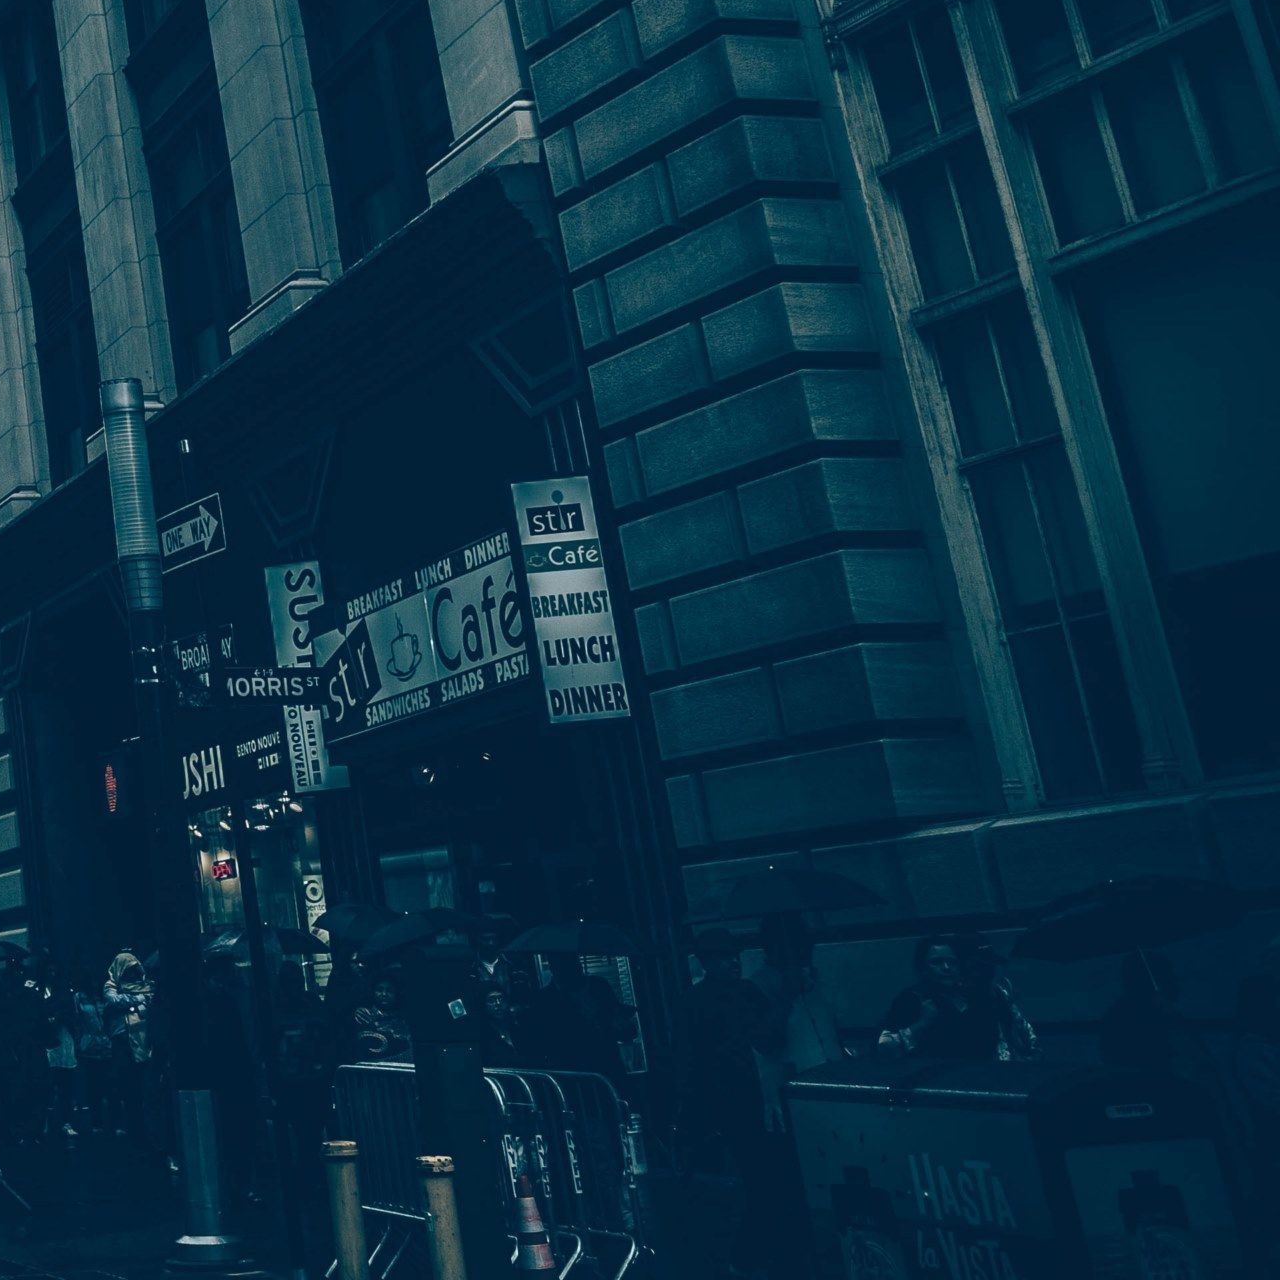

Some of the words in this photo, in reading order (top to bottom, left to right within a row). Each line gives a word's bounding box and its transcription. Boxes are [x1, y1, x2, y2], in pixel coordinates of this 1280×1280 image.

[165, 528, 185, 553] ONE
[190, 516, 211, 543] WAY
[532, 503, 578, 533] stir
[548, 545, 599, 565] Café
[346, 579, 403, 620] BREAKFAST
[414, 557, 453, 590] LUNCH
[463, 532, 511, 570] DINNER
[284, 567, 319, 668] SUS
[432, 570, 527, 671] Café
[531, 590, 609, 619] BREAKFAST
[181, 636, 232, 670] BROAAY
[543, 635, 616, 667] LUNCH
[306, 676, 320, 687] ST
[365, 688, 431, 727] SANDWICHES
[440, 669, 485, 702] SALADS
[549, 683, 628, 717] DINNER
[182, 744, 225, 800] SHI
[236, 741, 256, 758] BENTO
[257, 730, 281, 751] NOUVE
[288, 722, 308, 787] NOUVEAU
[212, 863, 234, 879] OPEN
[908, 1152, 1018, 1229] HASTA
[916, 1228, 941, 1270] la
